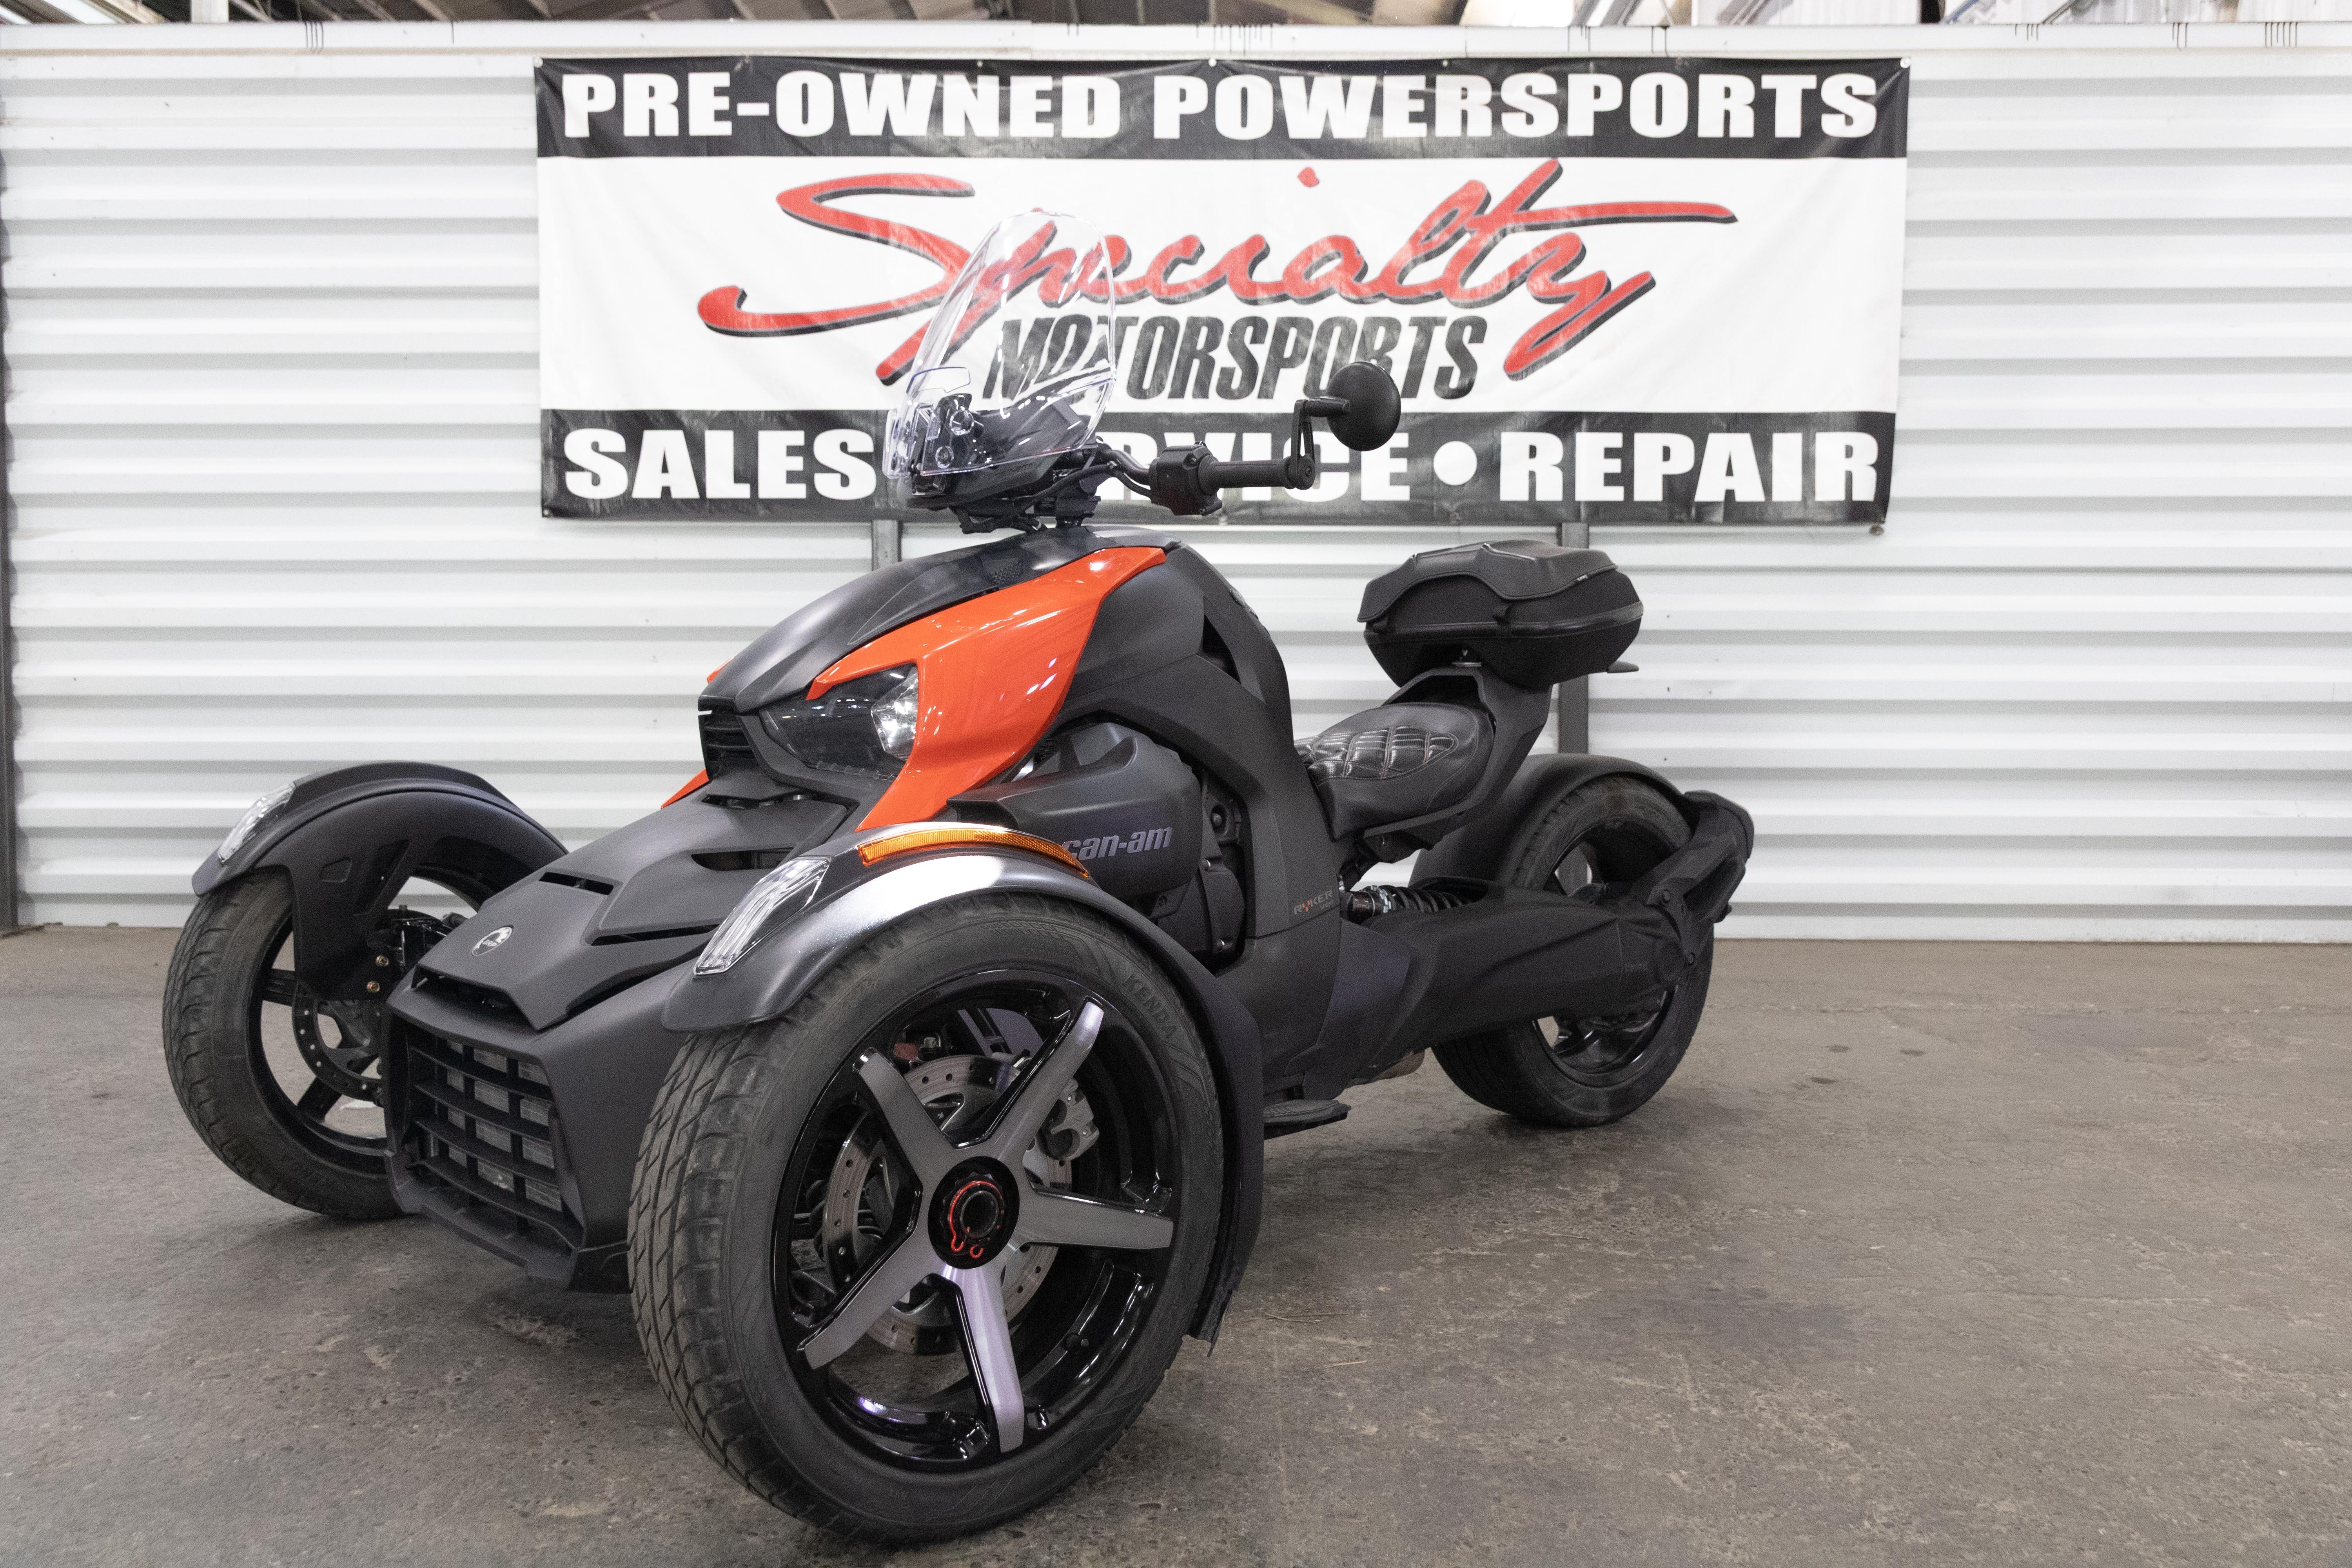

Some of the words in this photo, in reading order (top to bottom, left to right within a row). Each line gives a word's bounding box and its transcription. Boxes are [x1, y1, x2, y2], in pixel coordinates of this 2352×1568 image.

[562, 71, 1121, 138] PRE-OWNED
[1153, 72, 1877, 140] POWERSPORTS
[698, 158, 1739, 386] Specialty
[982, 315, 1488, 400] MOTORSPORTS
[564, 428, 877, 500] SALES
[1499, 431, 1878, 503] REPAIR
[1062, 826, 1172, 861] can-am
[1293, 889, 1332, 915] RYKER
[1122, 973, 1178, 1039] KENDA
